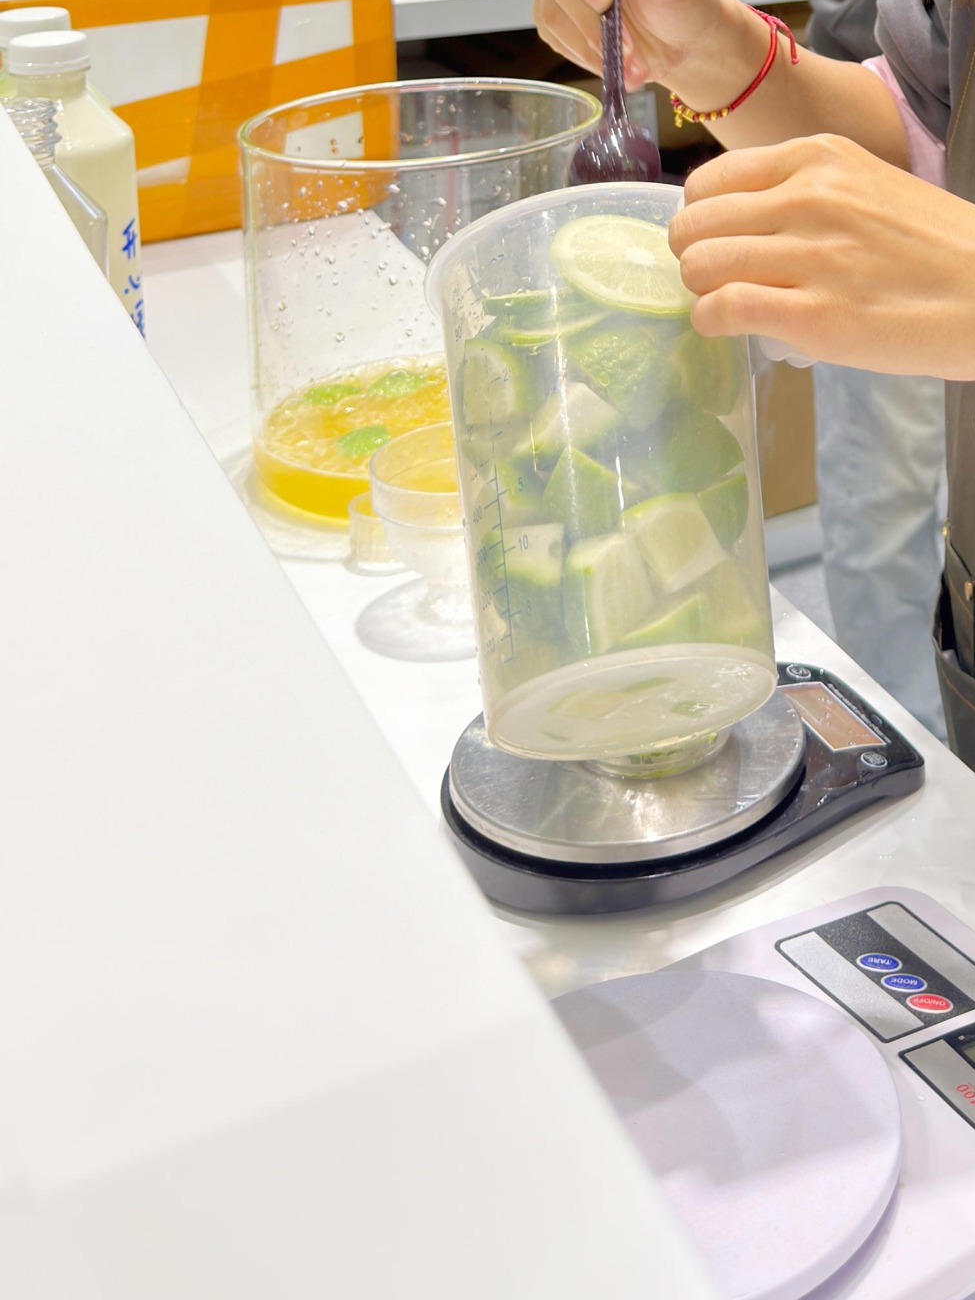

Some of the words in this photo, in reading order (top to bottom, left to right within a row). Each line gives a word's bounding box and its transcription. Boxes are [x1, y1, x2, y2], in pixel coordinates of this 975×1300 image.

[867, 956, 892, 966] TARE
[891, 976, 918, 986] MODE
[911, 996, 946, 1007] ON/OFF
